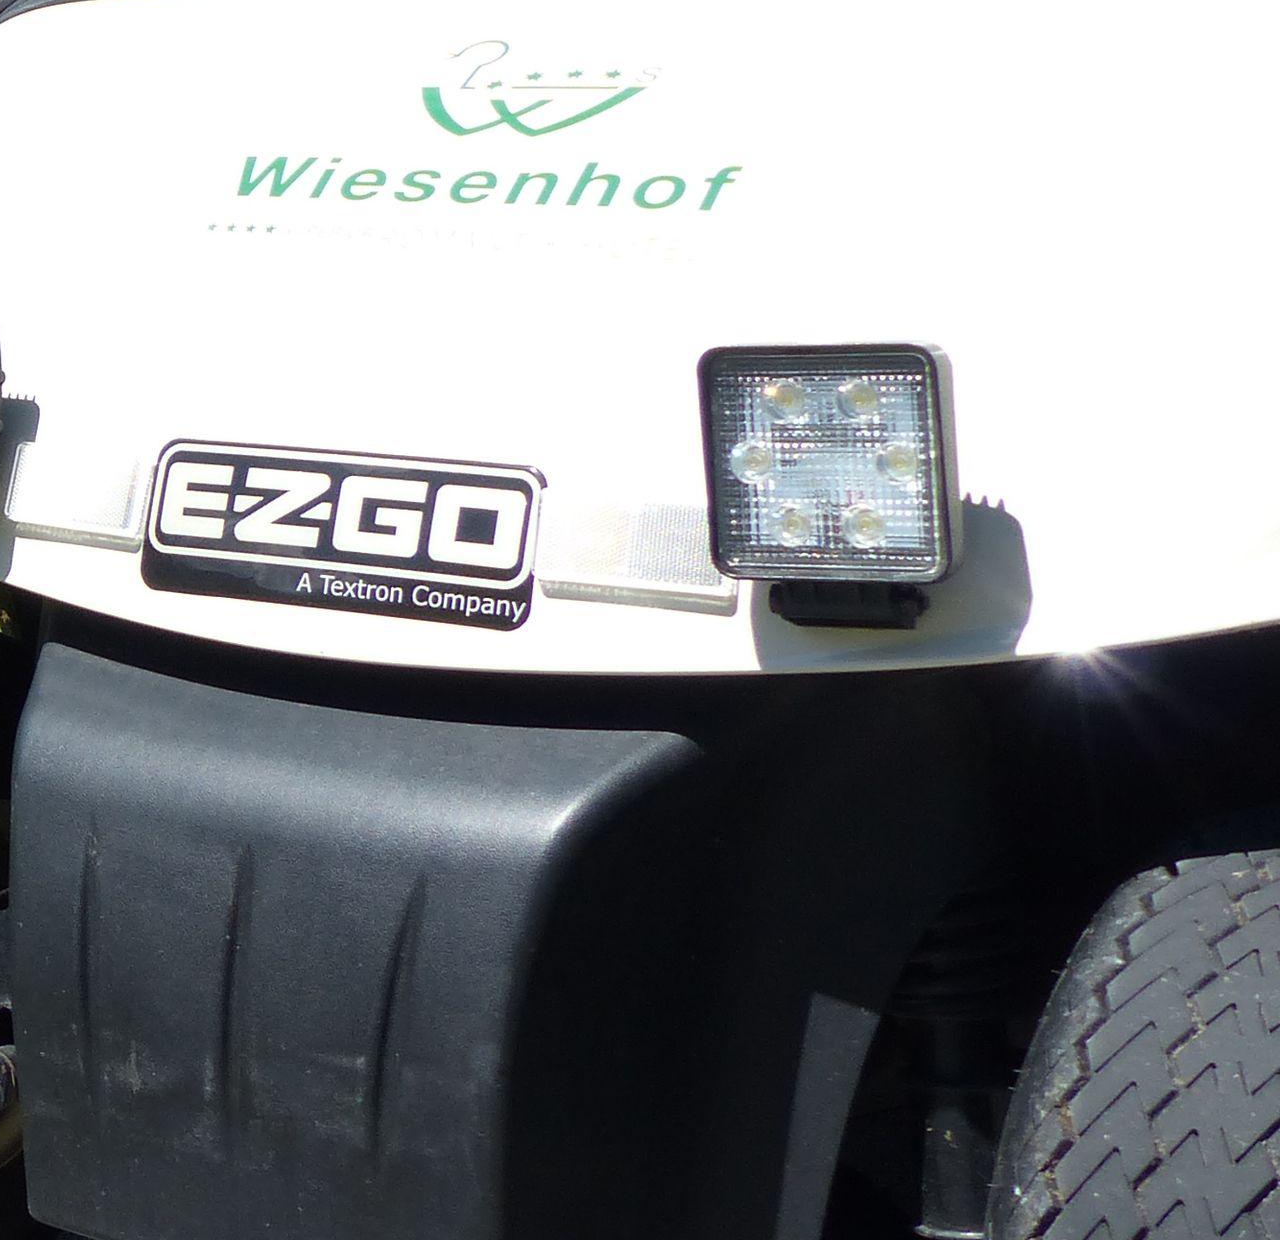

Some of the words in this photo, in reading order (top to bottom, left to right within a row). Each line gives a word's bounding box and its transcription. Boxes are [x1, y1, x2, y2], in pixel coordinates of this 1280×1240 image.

[235, 155, 742, 211] Wiesenhof
[296, 572, 312, 593] A
[320, 574, 403, 604] Textron
[411, 585, 526, 622] Company
